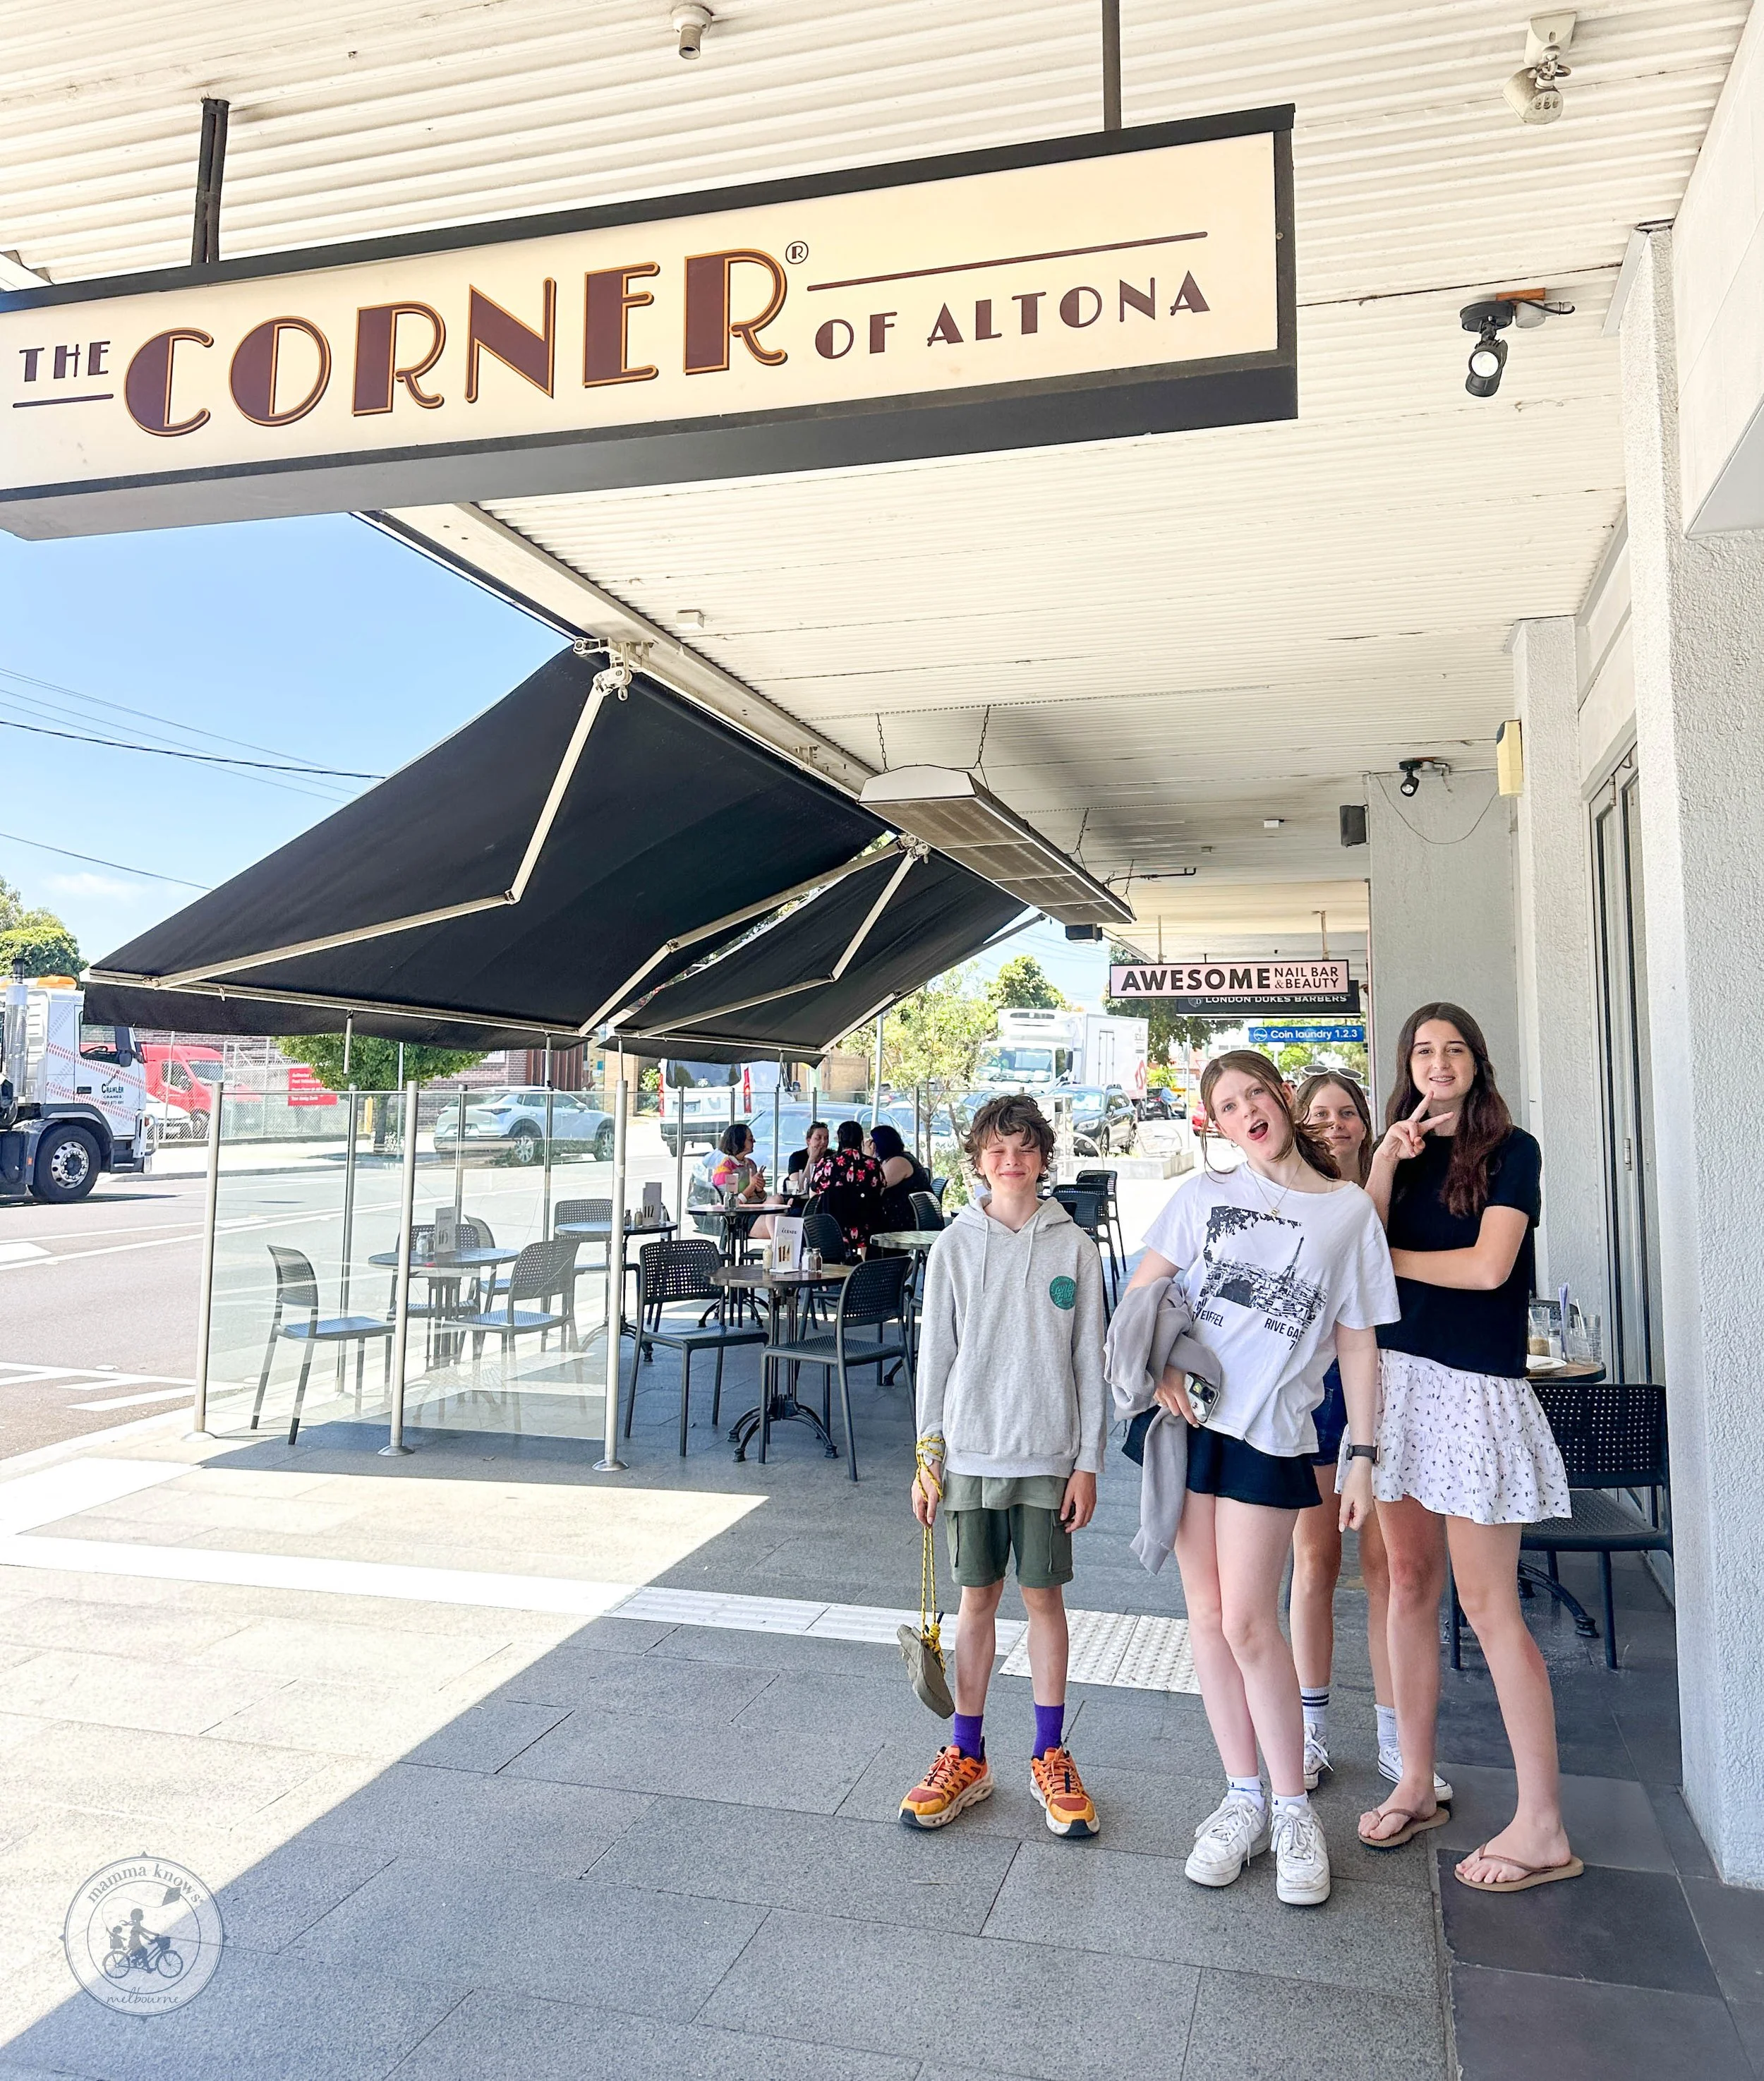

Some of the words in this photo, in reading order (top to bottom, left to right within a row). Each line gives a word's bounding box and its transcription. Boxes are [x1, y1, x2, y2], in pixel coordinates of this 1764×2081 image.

[814, 310, 898, 360] OF
[926, 270, 1211, 346] ALTONA
[123, 247, 789, 438] CORNER
[19, 340, 111, 382] THE
[1120, 967, 1270, 991] AWESOME
[1274, 967, 1307, 978] NAIL
[1312, 966, 1339, 977] BAR
[1270, 1029, 1293, 1039] Coin
[1295, 1028, 1332, 1040] laundry
[1334, 1029, 1358, 1038] 1.2.3
[644, 1204, 654, 1218] 112
[1200, 1309, 1225, 1328] EIFFEL
[1264, 1317, 1285, 1335] RIVE
